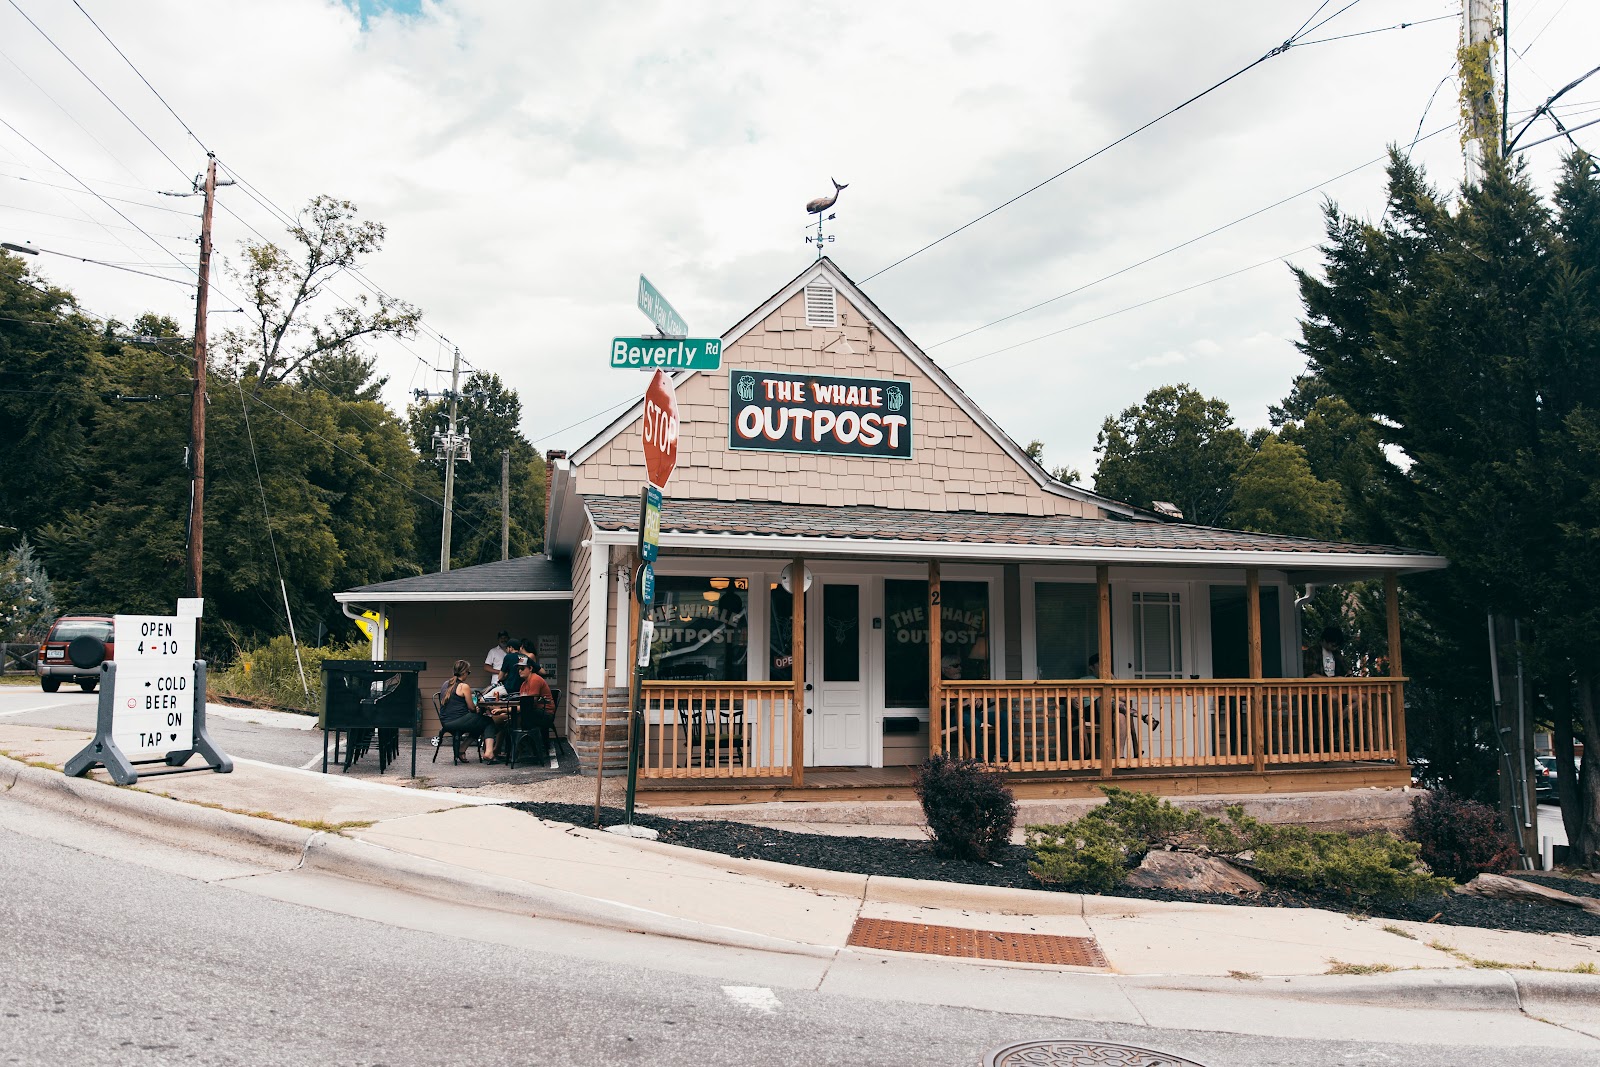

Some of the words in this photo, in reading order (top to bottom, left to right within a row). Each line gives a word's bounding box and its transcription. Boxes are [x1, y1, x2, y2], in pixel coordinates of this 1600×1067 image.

[640, 280, 654, 314] New
[612, 340, 697, 366] Beverly
[705, 342, 719, 355] Rd
[762, 379, 806, 403] THE
[810, 382, 883, 406] WHALE
[645, 399, 677, 455] STOP
[736, 404, 907, 449] OUTPOST
[932, 591, 940, 606] 2
[679, 604, 740, 627] WHALE
[890, 607, 924, 629] THE
[941, 607, 983, 629] HALE
[141, 622, 173, 637] OPEN
[897, 629, 977, 644] OUTOST
[137, 641, 144, 655] 4
[162, 640, 178, 655] 10
[775, 656, 793, 668] OPE
[157, 676, 186, 691] COLD
[145, 694, 177, 710] BEER
[167, 712, 182, 727] ON
[139, 732, 162, 748] TAP
